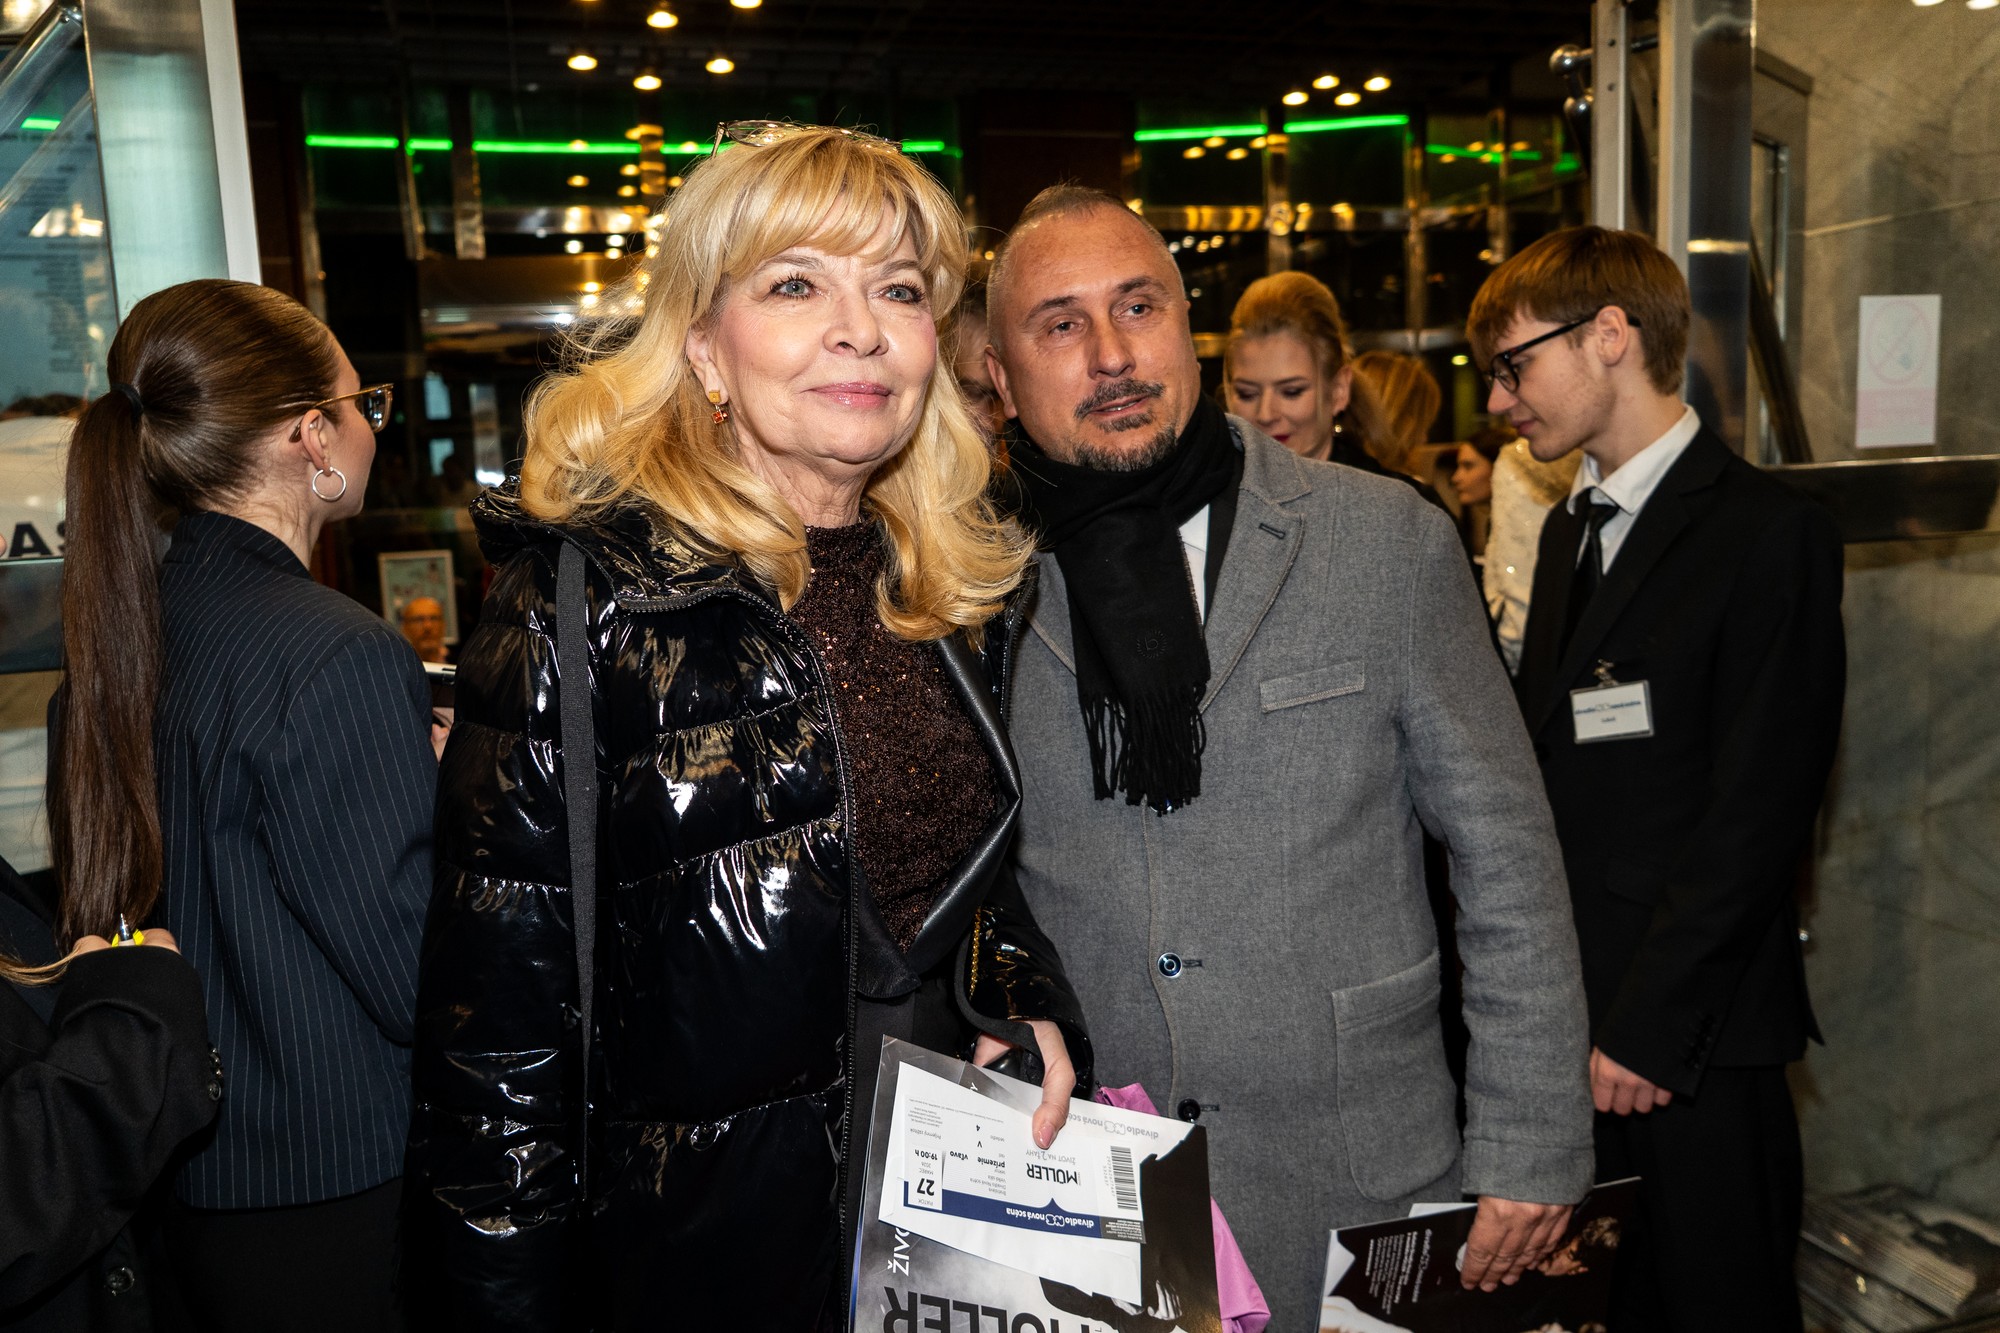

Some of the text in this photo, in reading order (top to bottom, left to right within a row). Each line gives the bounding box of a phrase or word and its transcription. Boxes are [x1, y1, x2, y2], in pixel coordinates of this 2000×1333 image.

[1068, 1112, 1082, 1122] scé
[1082, 1116, 1103, 1127] nová
[1126, 1125, 1159, 1139] divadlo
[977, 1140, 983, 1148] V
[914, 1149, 938, 1160] 19:00 h
[1041, 1151, 1048, 1161] 2
[977, 1156, 1005, 1168] prízemie
[1058, 1156, 1076, 1166] ŽIVOT
[1026, 1162, 1078, 1185] MÜLLER
[916, 1178, 935, 1196] 27
[1006, 1207, 1027, 1218] scéna
[1027, 1211, 1045, 1220] nová
[1065, 1216, 1095, 1229] divadlo
